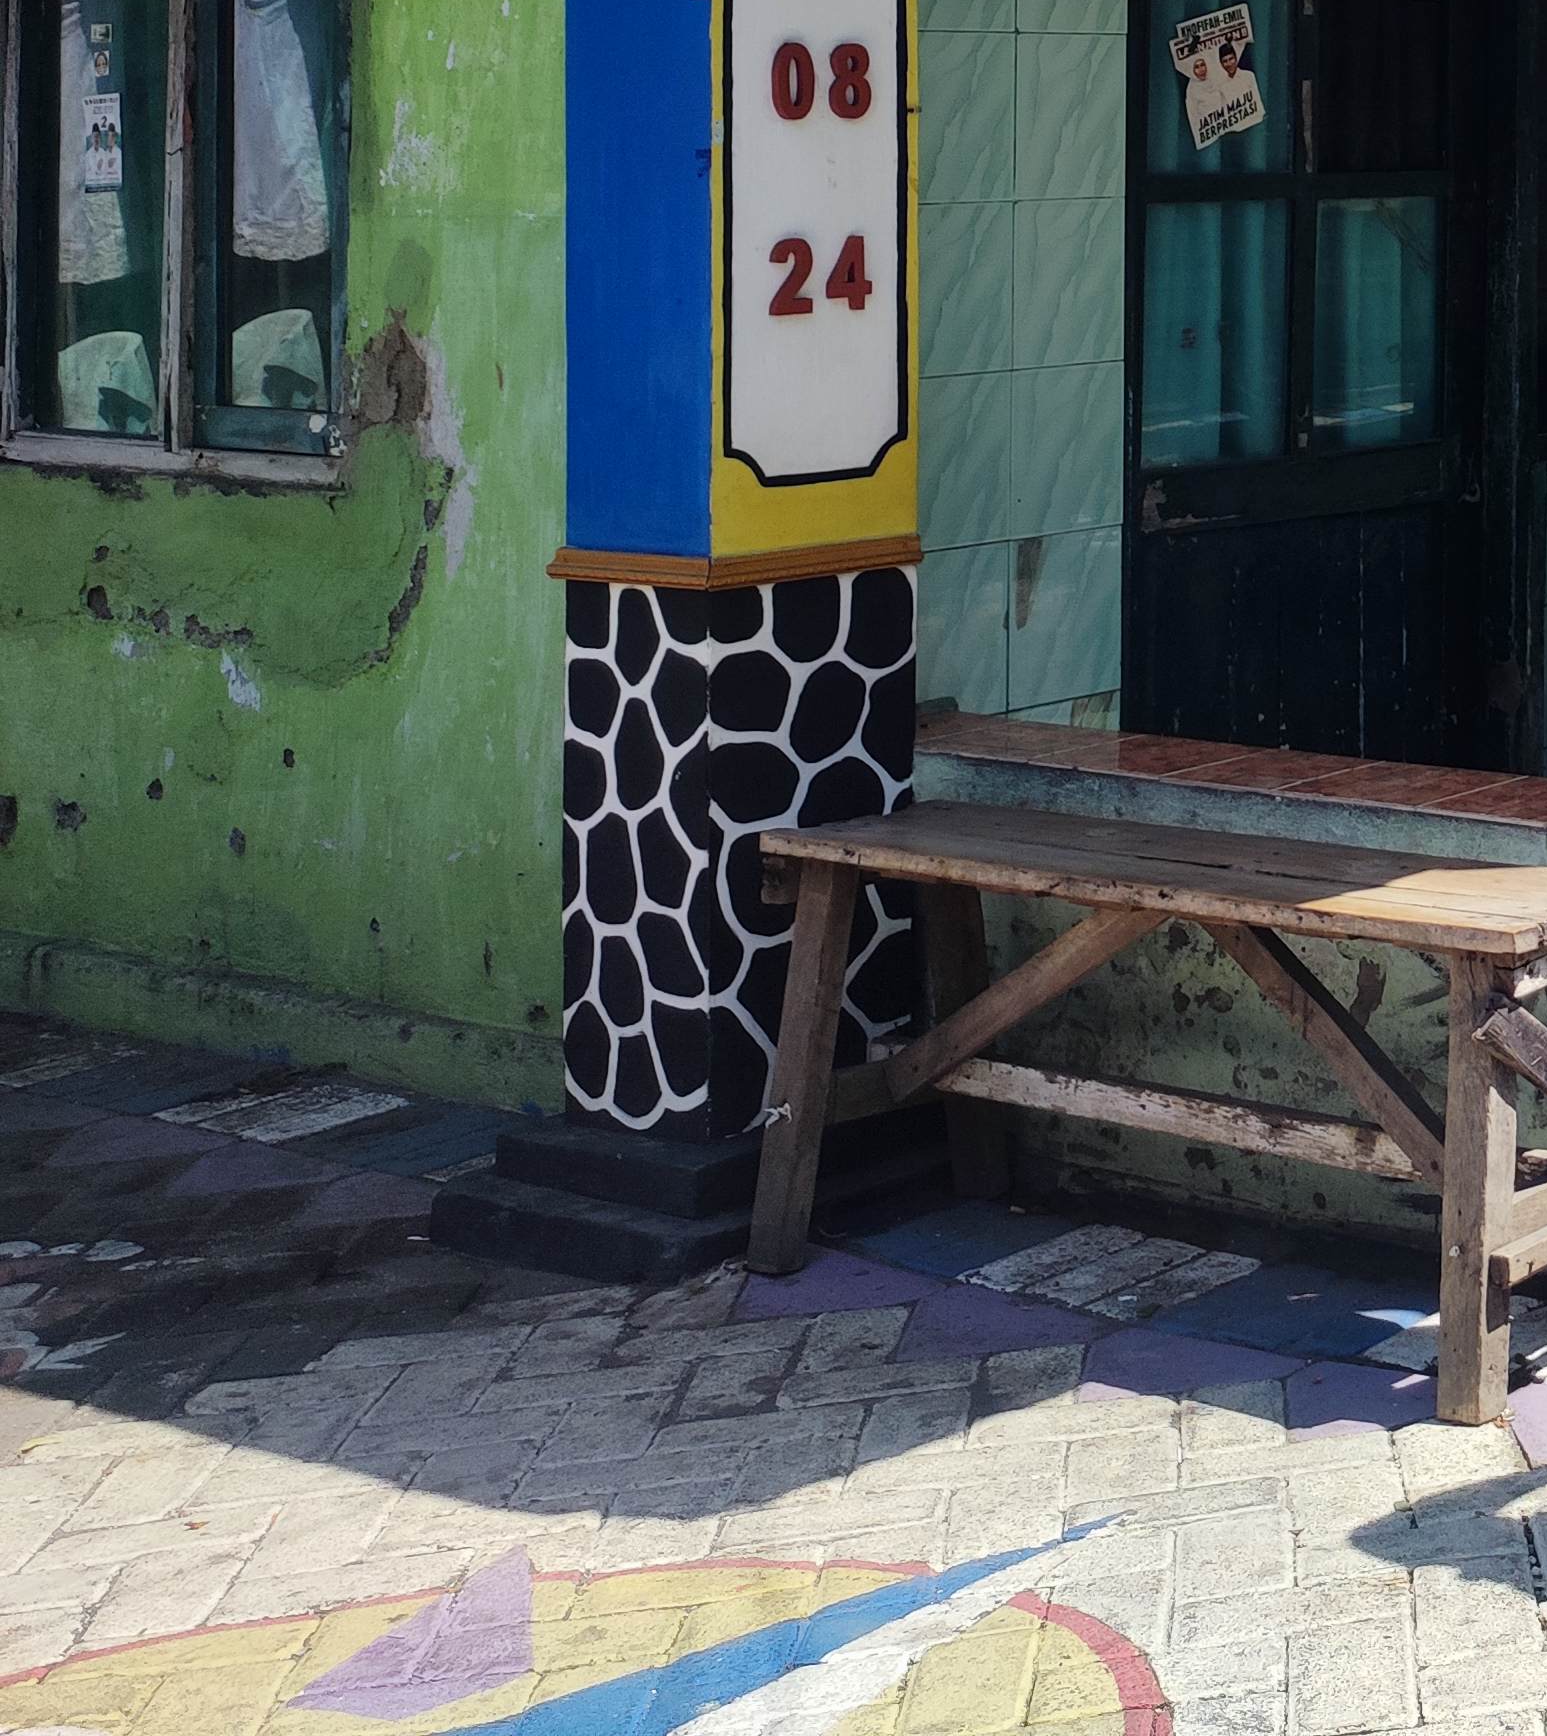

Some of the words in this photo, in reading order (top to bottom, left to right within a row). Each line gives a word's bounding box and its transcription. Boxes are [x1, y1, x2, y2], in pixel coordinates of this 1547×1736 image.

[770, 41, 873, 121] 08
[1199, 108, 1225, 131] JATIM
[1226, 90, 1253, 111] MAJU
[1200, 101, 1258, 144] BERPRESTASI
[768, 234, 874, 318] 24
